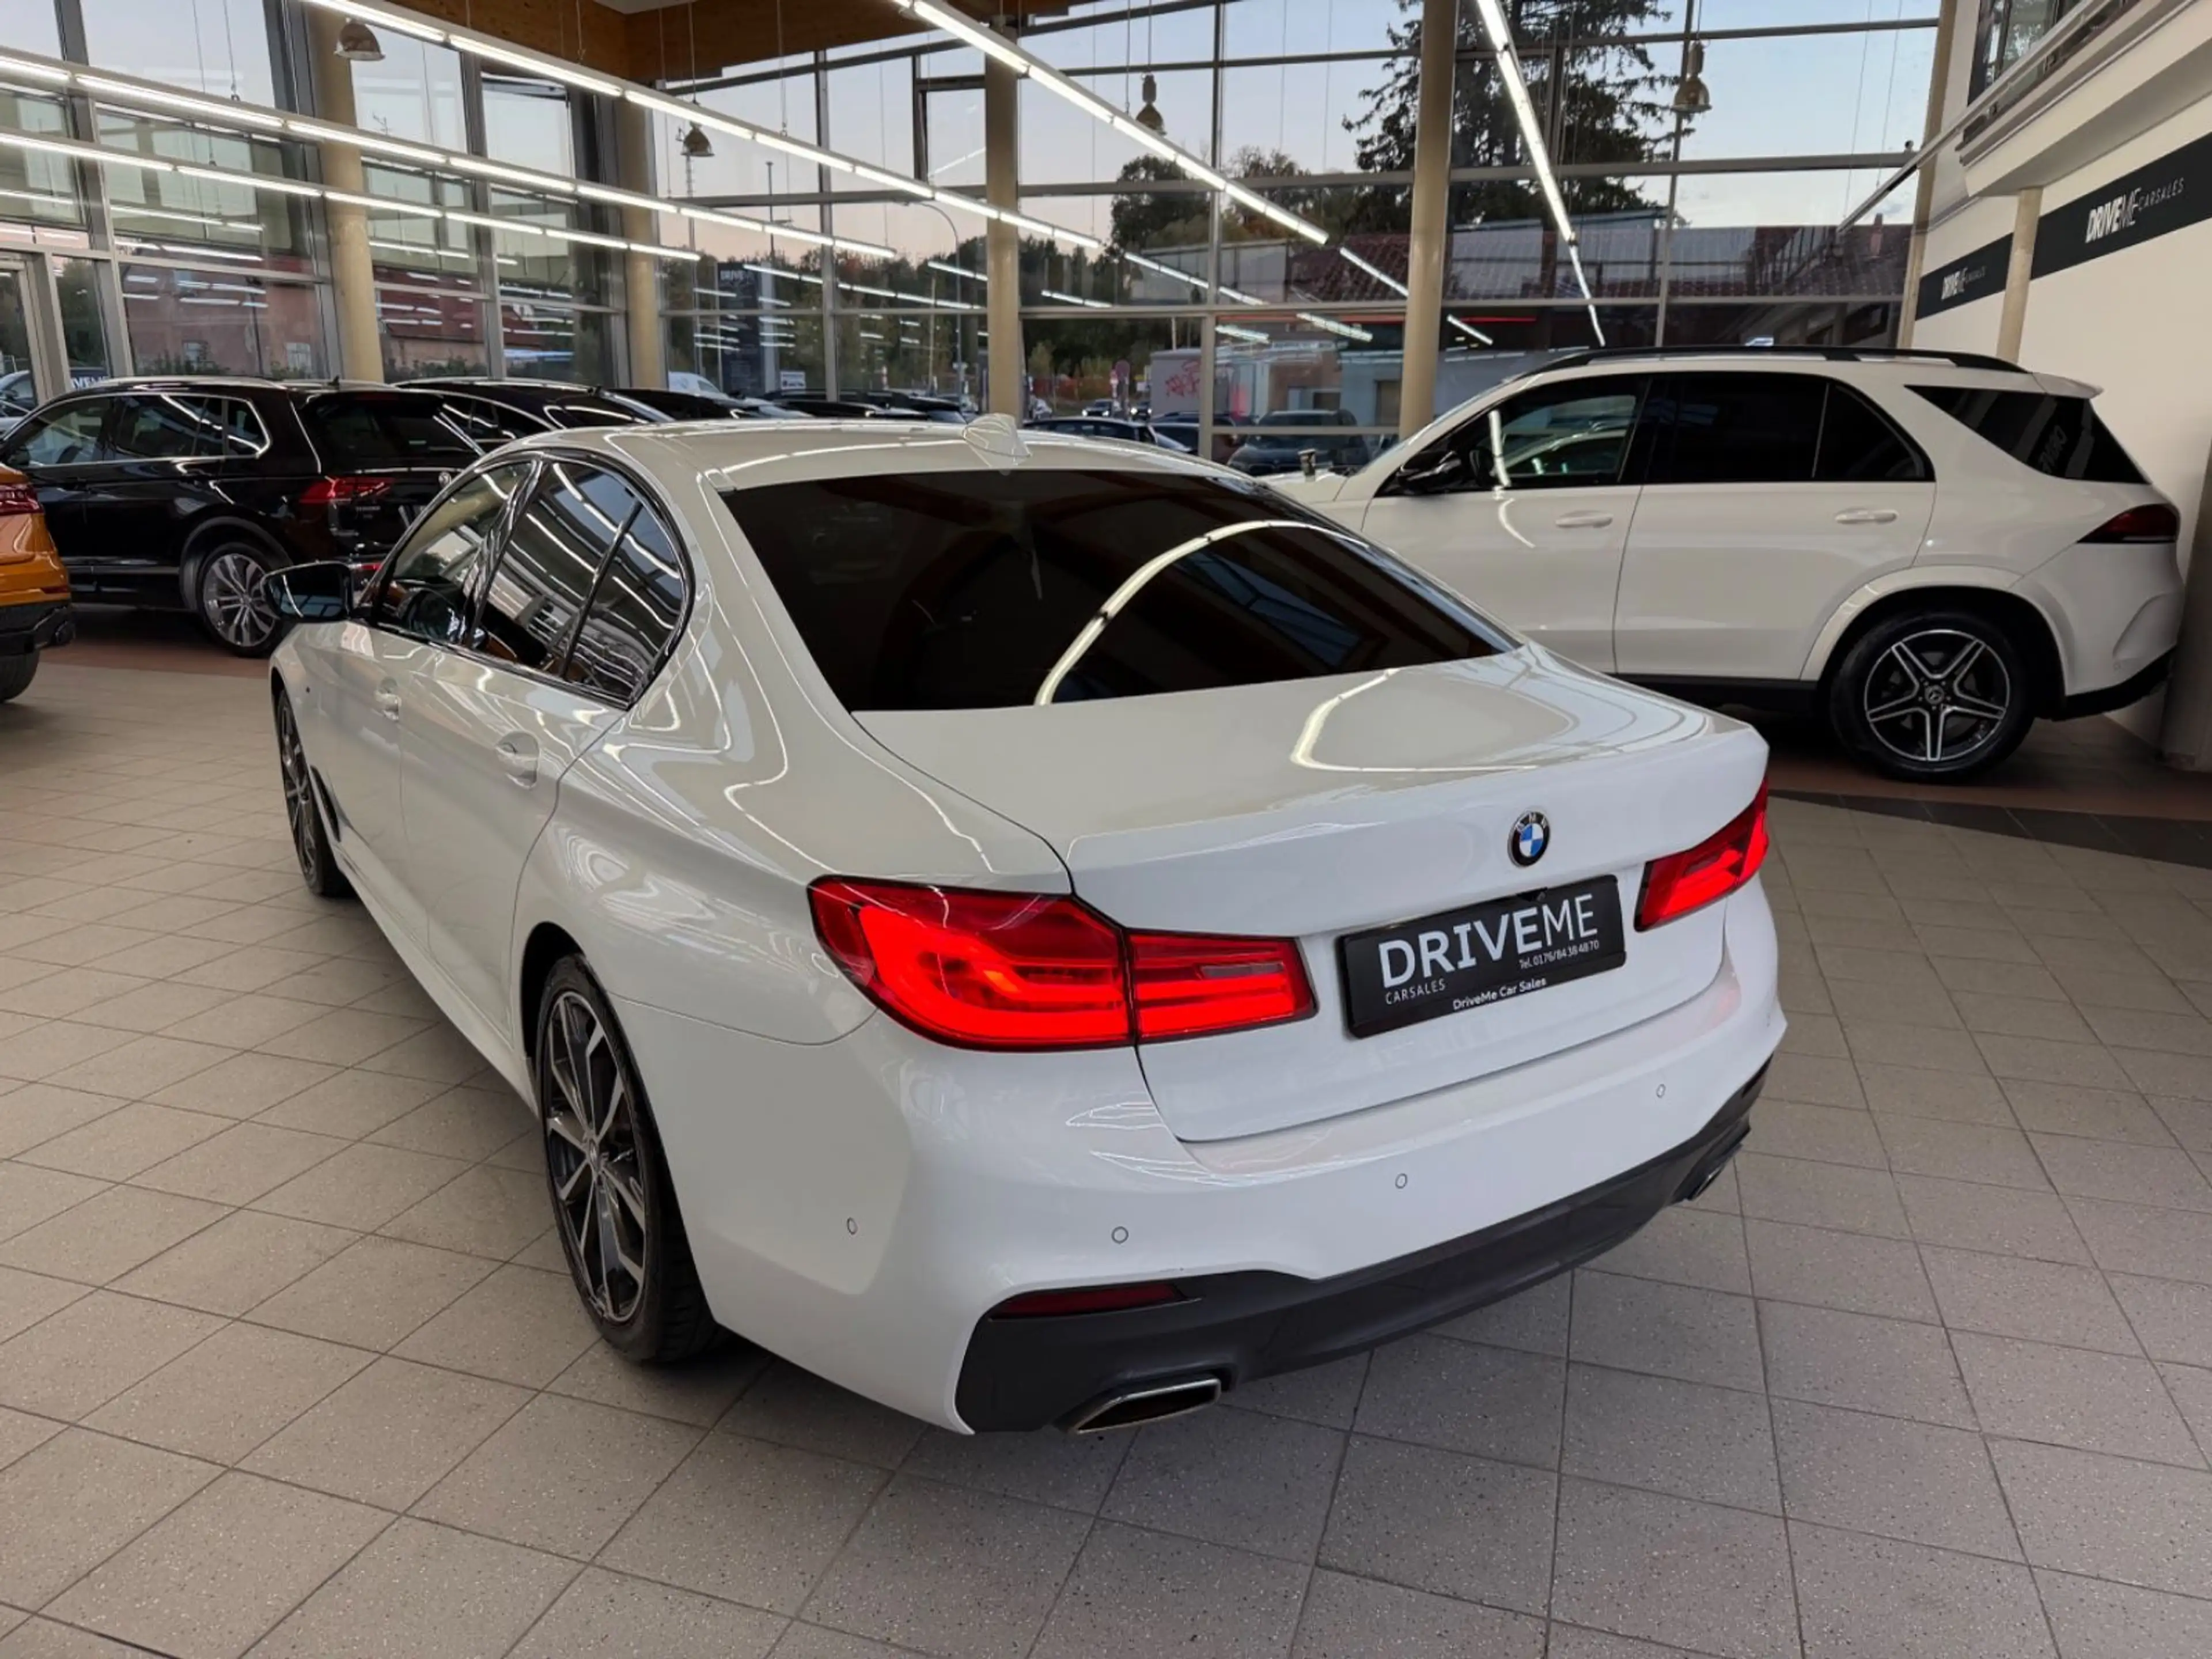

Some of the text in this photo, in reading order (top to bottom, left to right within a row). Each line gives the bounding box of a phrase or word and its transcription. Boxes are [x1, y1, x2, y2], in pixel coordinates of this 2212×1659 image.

[2085, 177, 2185, 244] DRIVEME CARSALES
[1378, 893, 1598, 989] DRIVEME
[1385, 978, 1446, 1005] CARSALES
[1452, 978, 1547, 1010] DriveMe Car Sales
